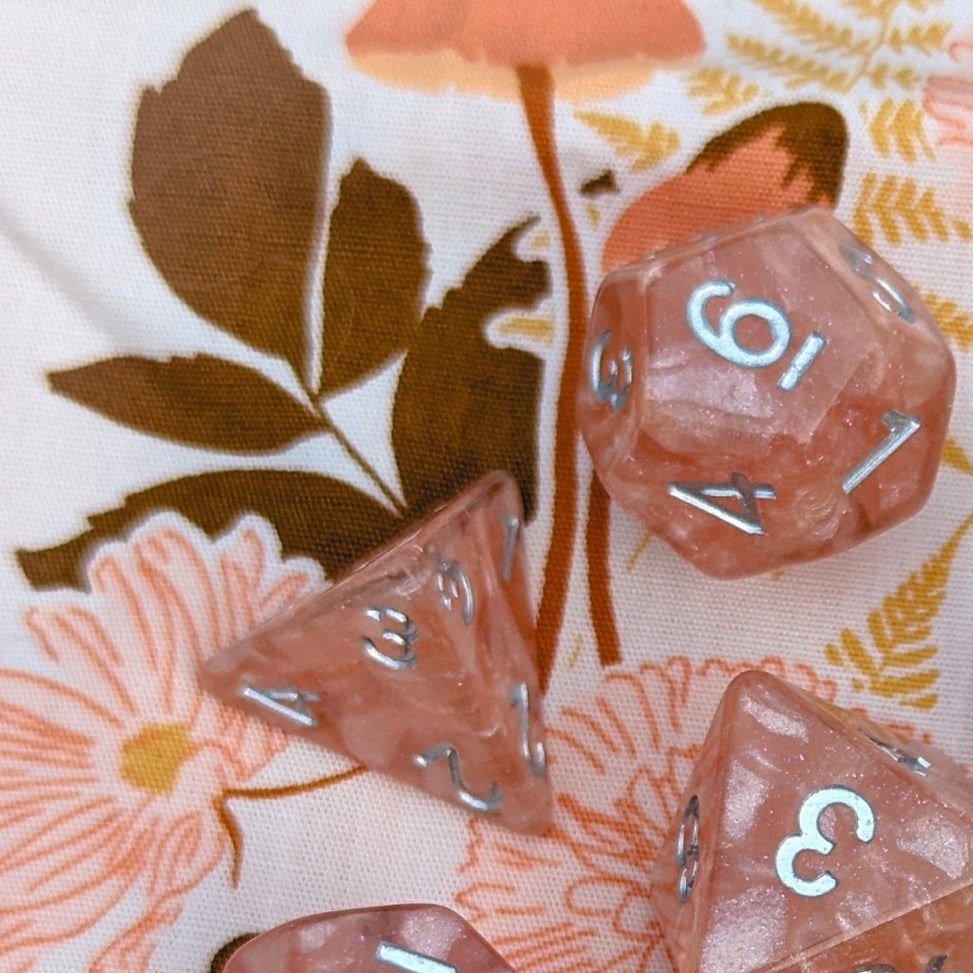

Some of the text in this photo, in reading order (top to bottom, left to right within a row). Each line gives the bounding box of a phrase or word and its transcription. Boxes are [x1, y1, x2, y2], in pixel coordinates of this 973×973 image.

[686, 280, 793, 369] 6
[842, 408, 921, 494] 1
[668, 472, 776, 535] 4
[361, 606, 418, 670] 3
[242, 678, 320, 726] 4
[414, 743, 502, 811] 2
[774, 784, 877, 897] 3
